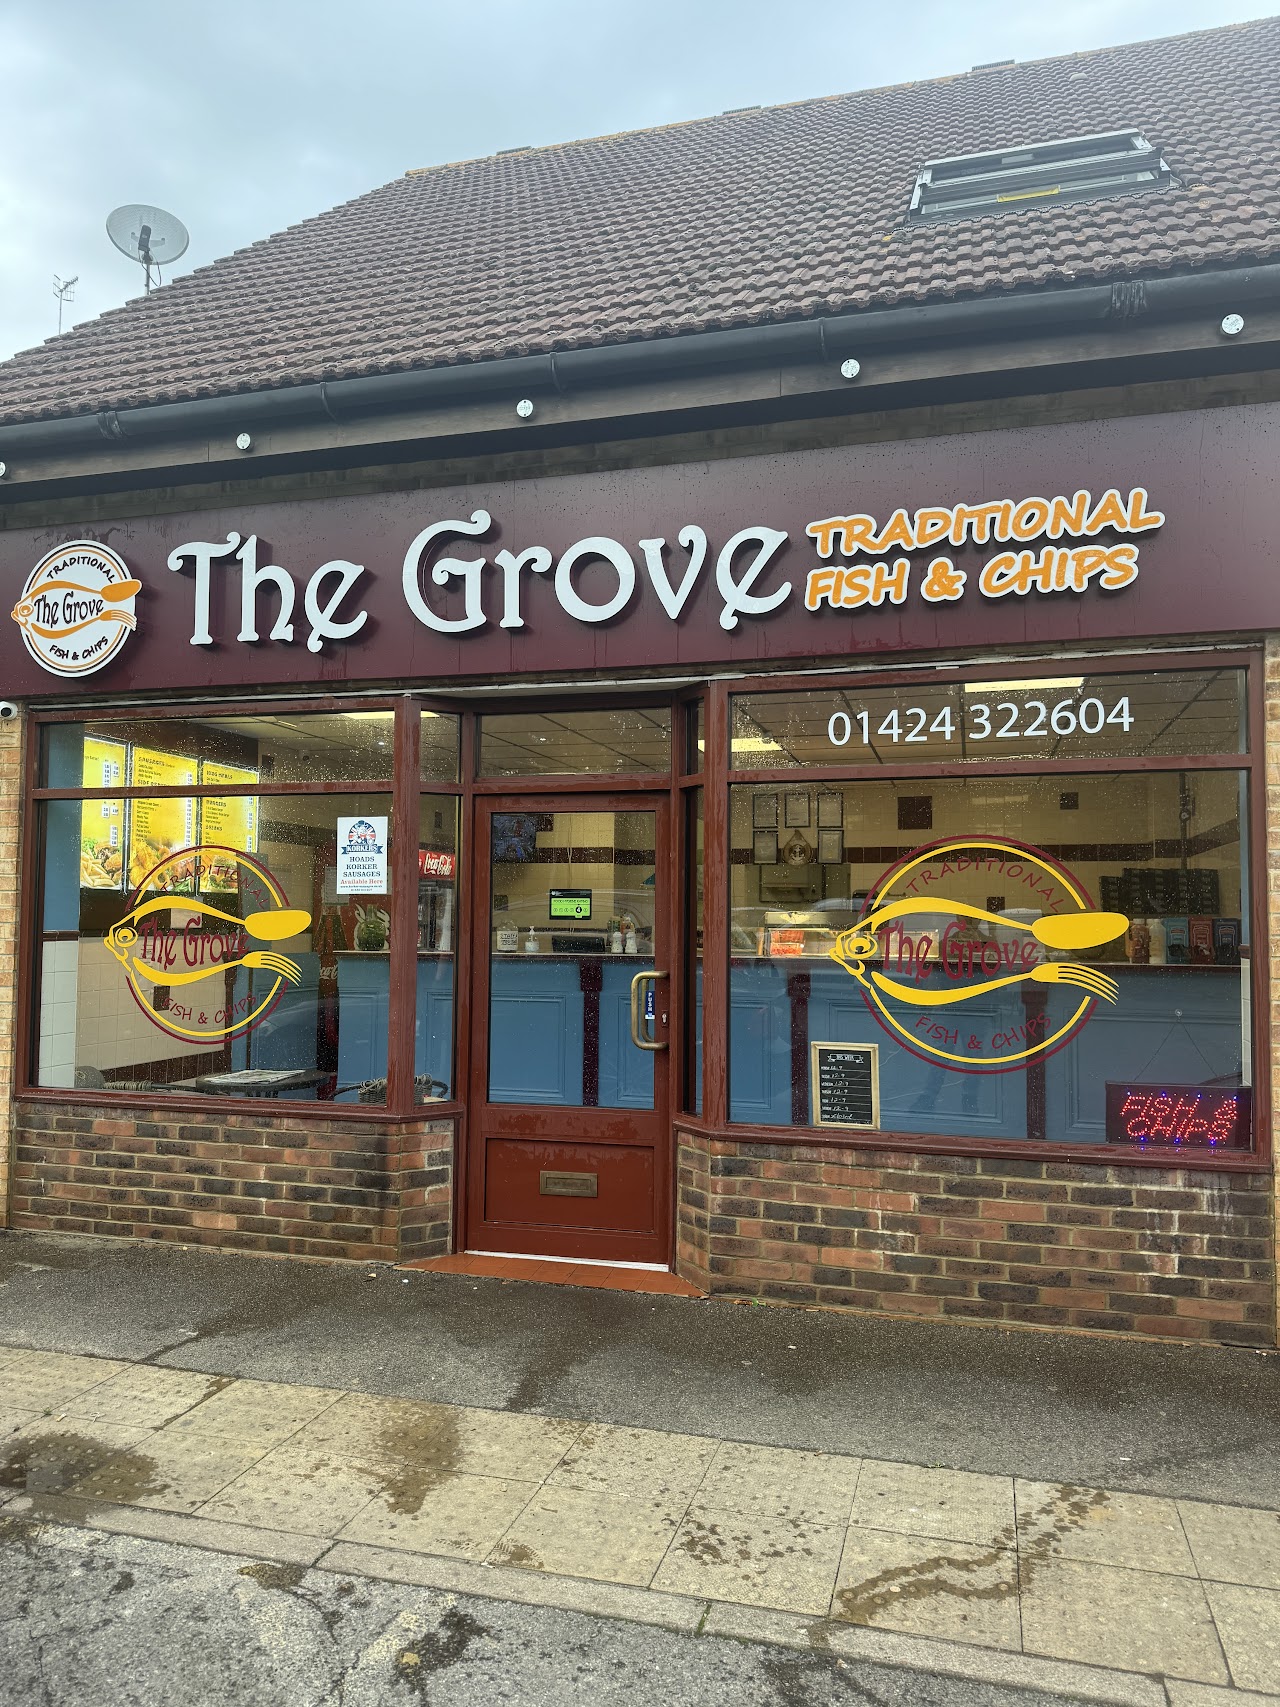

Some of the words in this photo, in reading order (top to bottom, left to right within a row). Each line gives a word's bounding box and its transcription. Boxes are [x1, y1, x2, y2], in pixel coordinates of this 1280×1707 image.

[806, 487, 1165, 558] TRADITIONAL
[47, 556, 116, 583] TRADITIONAL
[167, 531, 368, 653] The
[402, 509, 792, 634] Grove
[805, 557, 910, 611] FISH
[920, 556, 965, 601] &
[979, 543, 1139, 598] CHIPS
[34, 594, 59, 628] The
[62, 591, 104, 624] Grove
[49, 644, 70, 659] FISH
[71, 651, 79, 660] &
[82, 636, 108, 659] CHIPS
[827, 705, 956, 746] 01424
[968, 696, 1134, 740] 322604
[160, 864, 269, 909] TRADITIONAL
[906, 857, 1066, 913] TRADITIONAL
[139, 917, 177, 970] The
[183, 916, 251, 967] Grove
[878, 920, 934, 984] The
[942, 919, 1039, 980] Grove
[162, 997, 193, 1021] FISH
[197, 1012, 208, 1025] &
[215, 992, 257, 1025] CHIPS
[915, 1015, 959, 1046] FISH
[967, 1035, 983, 1050] &
[991, 1013, 1052, 1050] CHIPS
[1120, 1095, 1200, 1118] FISH
[1214, 1099, 1238, 1120] &
[1126, 1116, 1233, 1140] CHIPS
